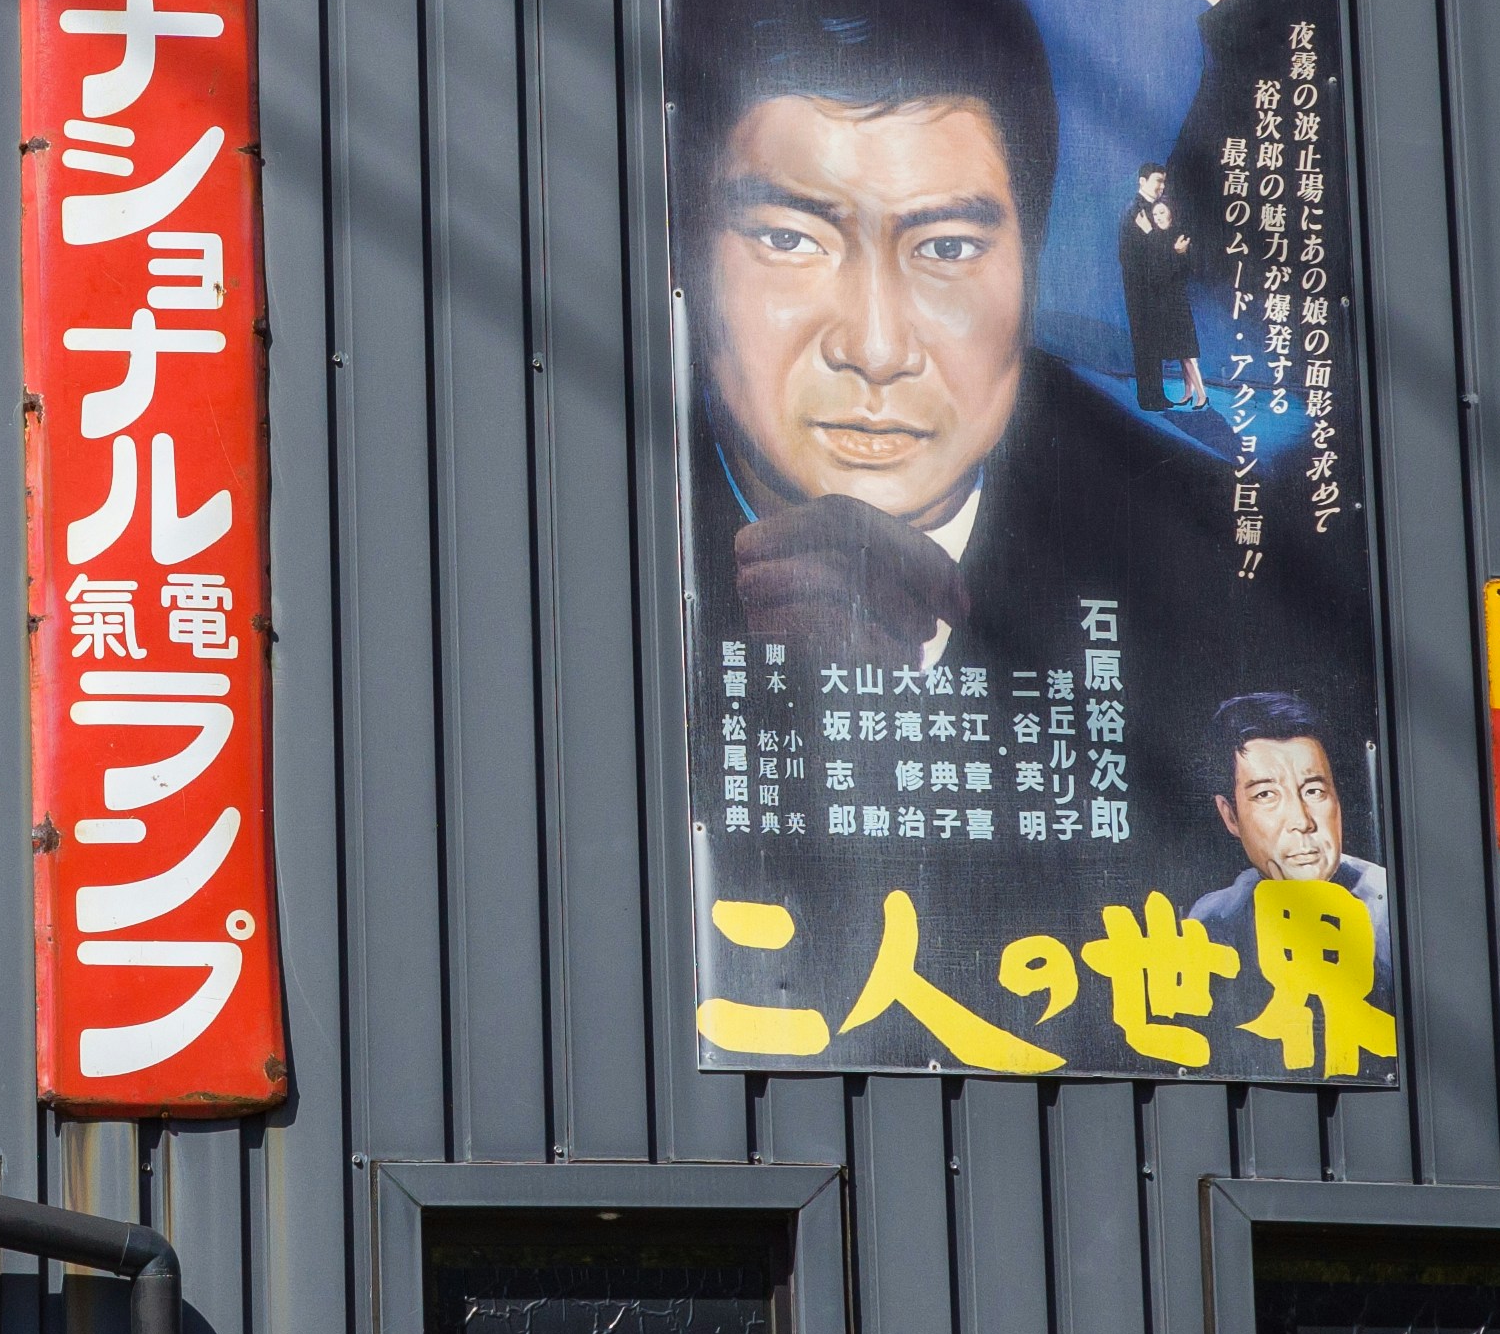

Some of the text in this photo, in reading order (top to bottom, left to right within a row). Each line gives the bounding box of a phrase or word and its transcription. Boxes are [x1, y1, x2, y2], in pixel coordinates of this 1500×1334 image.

[1253, 79, 1292, 414] 裕次郎の魅力が爆発する
[1288, 21, 1340, 533] 夜霧の波止場にあの娘の面影を求めて
[757, 730, 781, 835] 松尾昭典
[820, 663, 857, 836] 大坂志郎
[925, 666, 961, 839] 松本典子
[959, 666, 995, 840] 深江章喜
[1012, 671, 1047, 841] 二谷英明
[1046, 669, 1083, 841] 浅丘ルリ子
[1080, 599, 1130, 844] 石原裕次郎
[697, 879, 1397, 1078] 二人の世界
